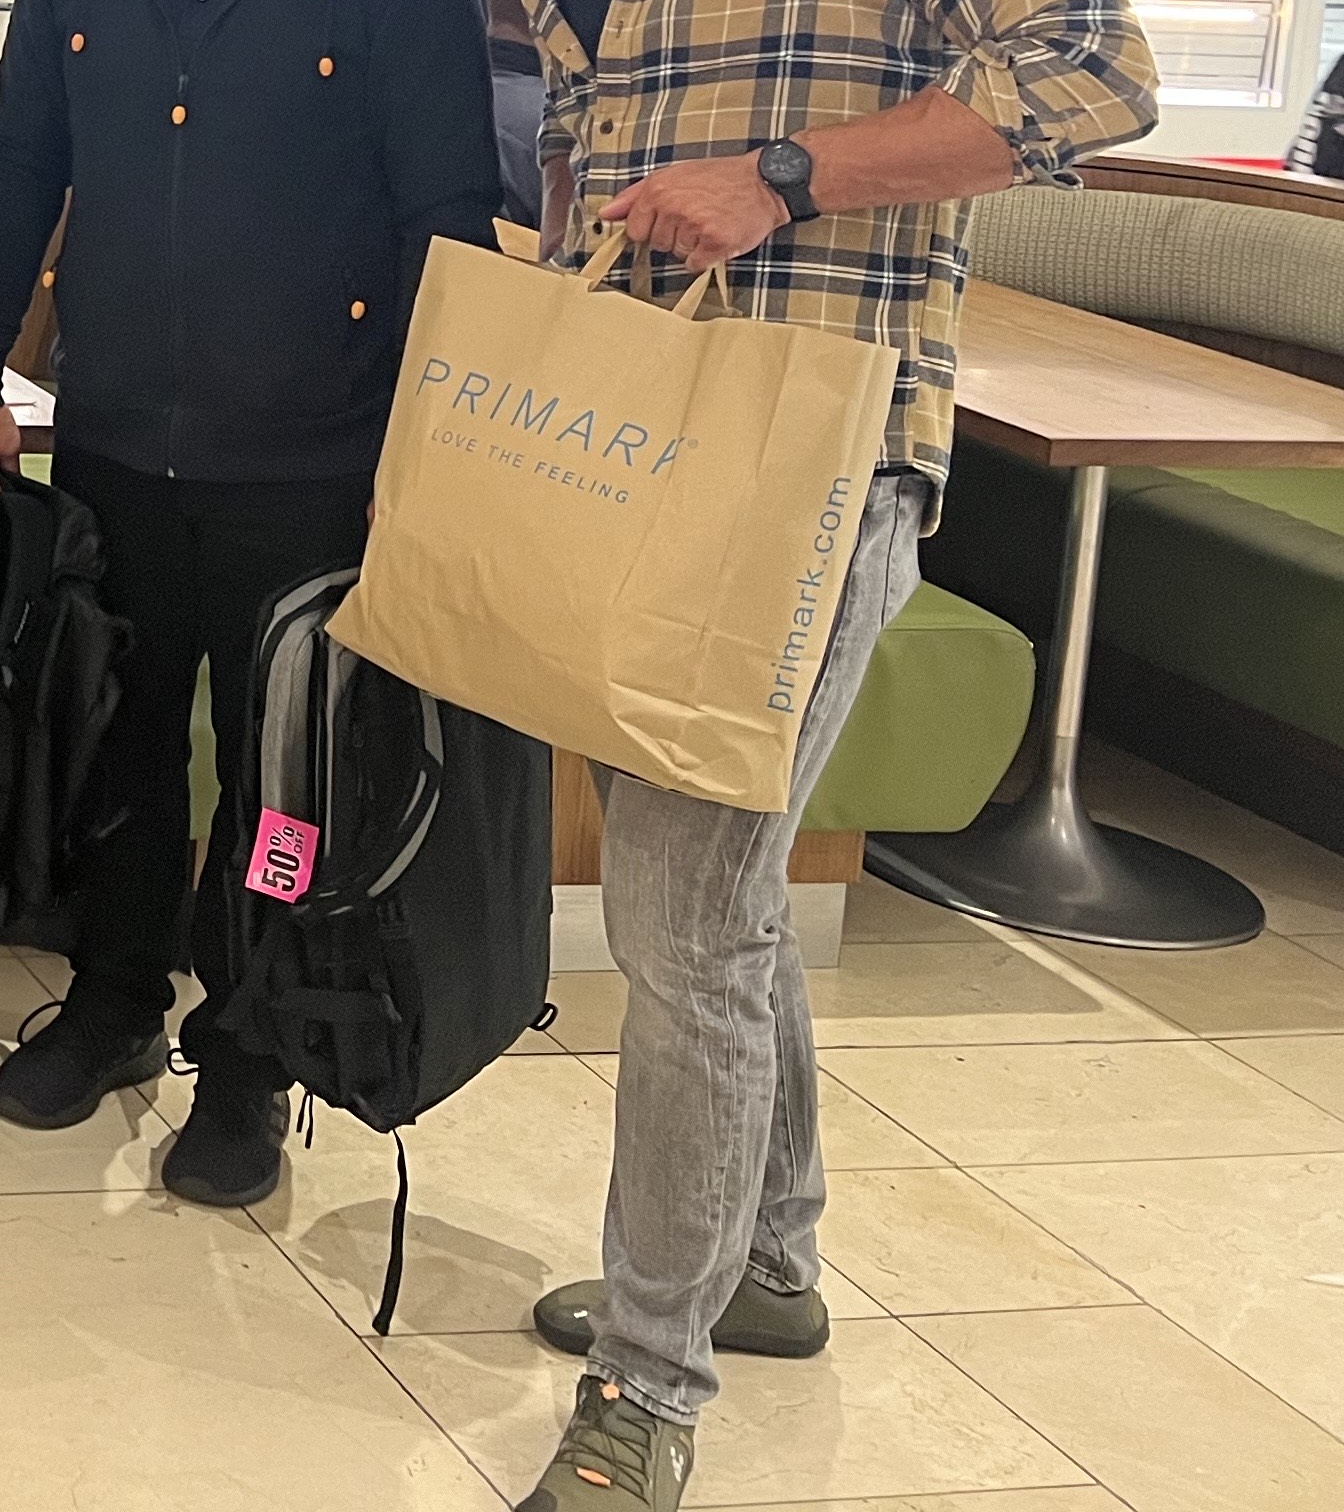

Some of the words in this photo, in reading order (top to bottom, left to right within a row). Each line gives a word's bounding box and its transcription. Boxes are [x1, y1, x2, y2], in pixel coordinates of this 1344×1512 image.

[430, 427, 478, 453] LOVE
[487, 444, 525, 469] THE
[533, 461, 630, 504] FEELING
[767, 476, 852, 714] primark.com
[261, 825, 300, 892] 50%
[293, 830, 305, 854] OFF
